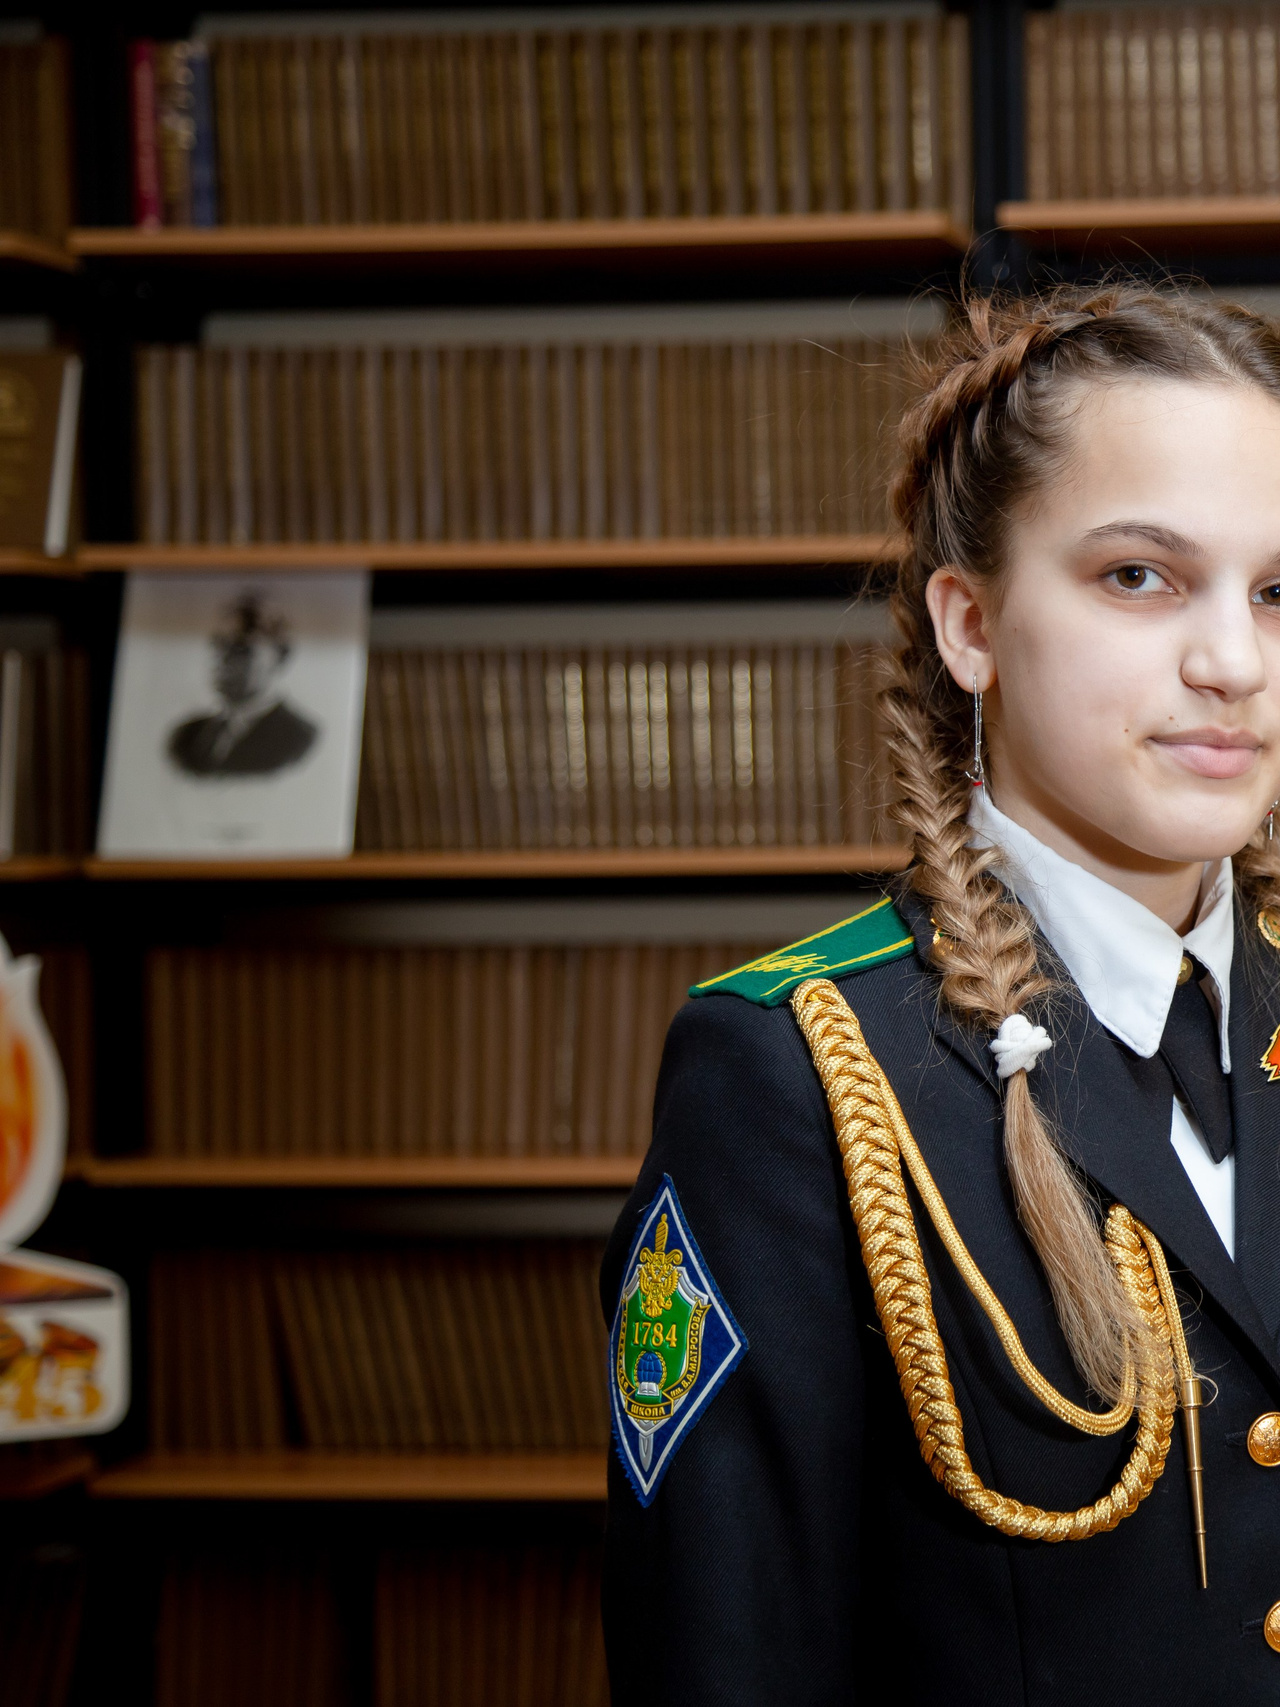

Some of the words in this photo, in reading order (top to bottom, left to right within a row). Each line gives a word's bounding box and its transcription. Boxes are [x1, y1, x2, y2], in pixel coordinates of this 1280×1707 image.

[633, 1322, 677, 1347] 1784
[688, 1308, 703, 1372] МАТРОСОВА
[631, 1404, 665, 1416] ШКОЛА
